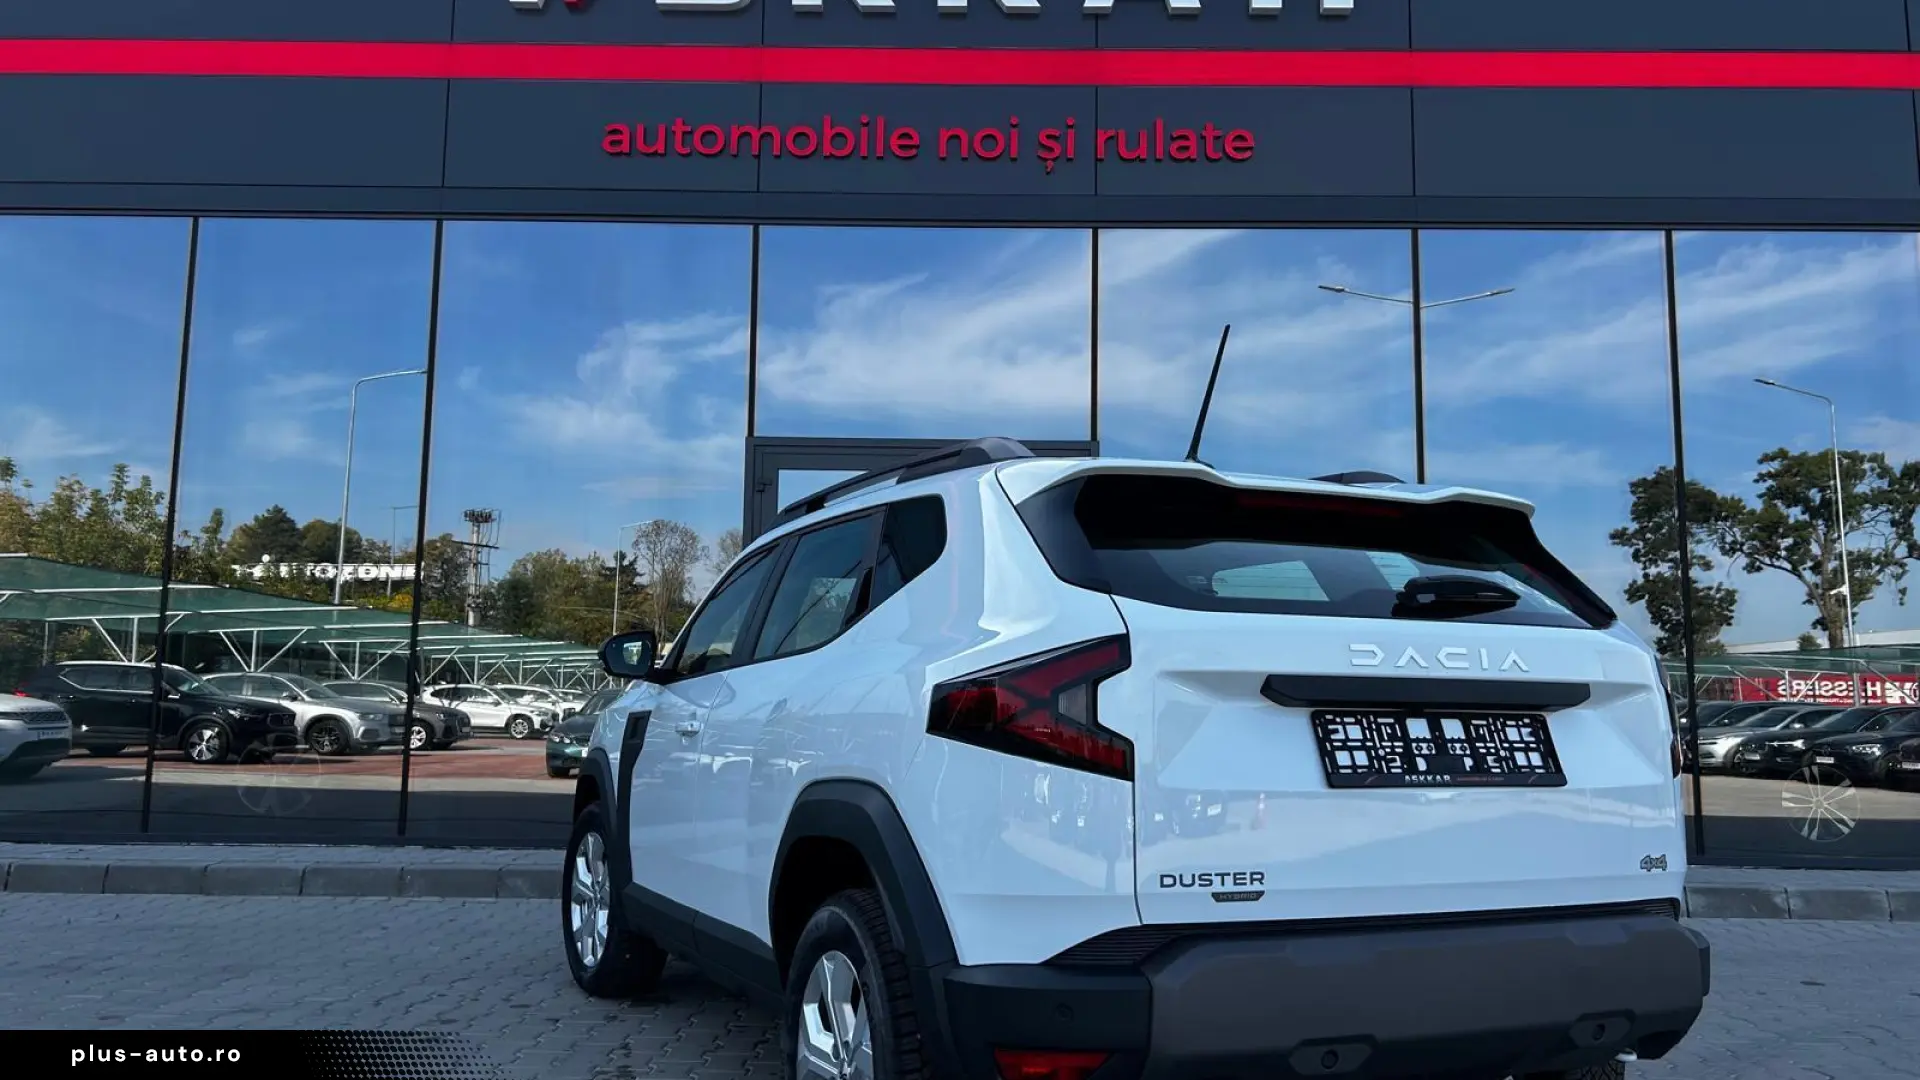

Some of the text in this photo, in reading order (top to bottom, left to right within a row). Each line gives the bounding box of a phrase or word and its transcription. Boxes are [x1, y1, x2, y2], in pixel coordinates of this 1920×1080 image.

[602, 115, 1256, 172] automobile noi și rulate
[1349, 643, 1530, 672] DACIA
[1159, 871, 1266, 889] DUSTER
[1219, 892, 1259, 900] HYBRID
